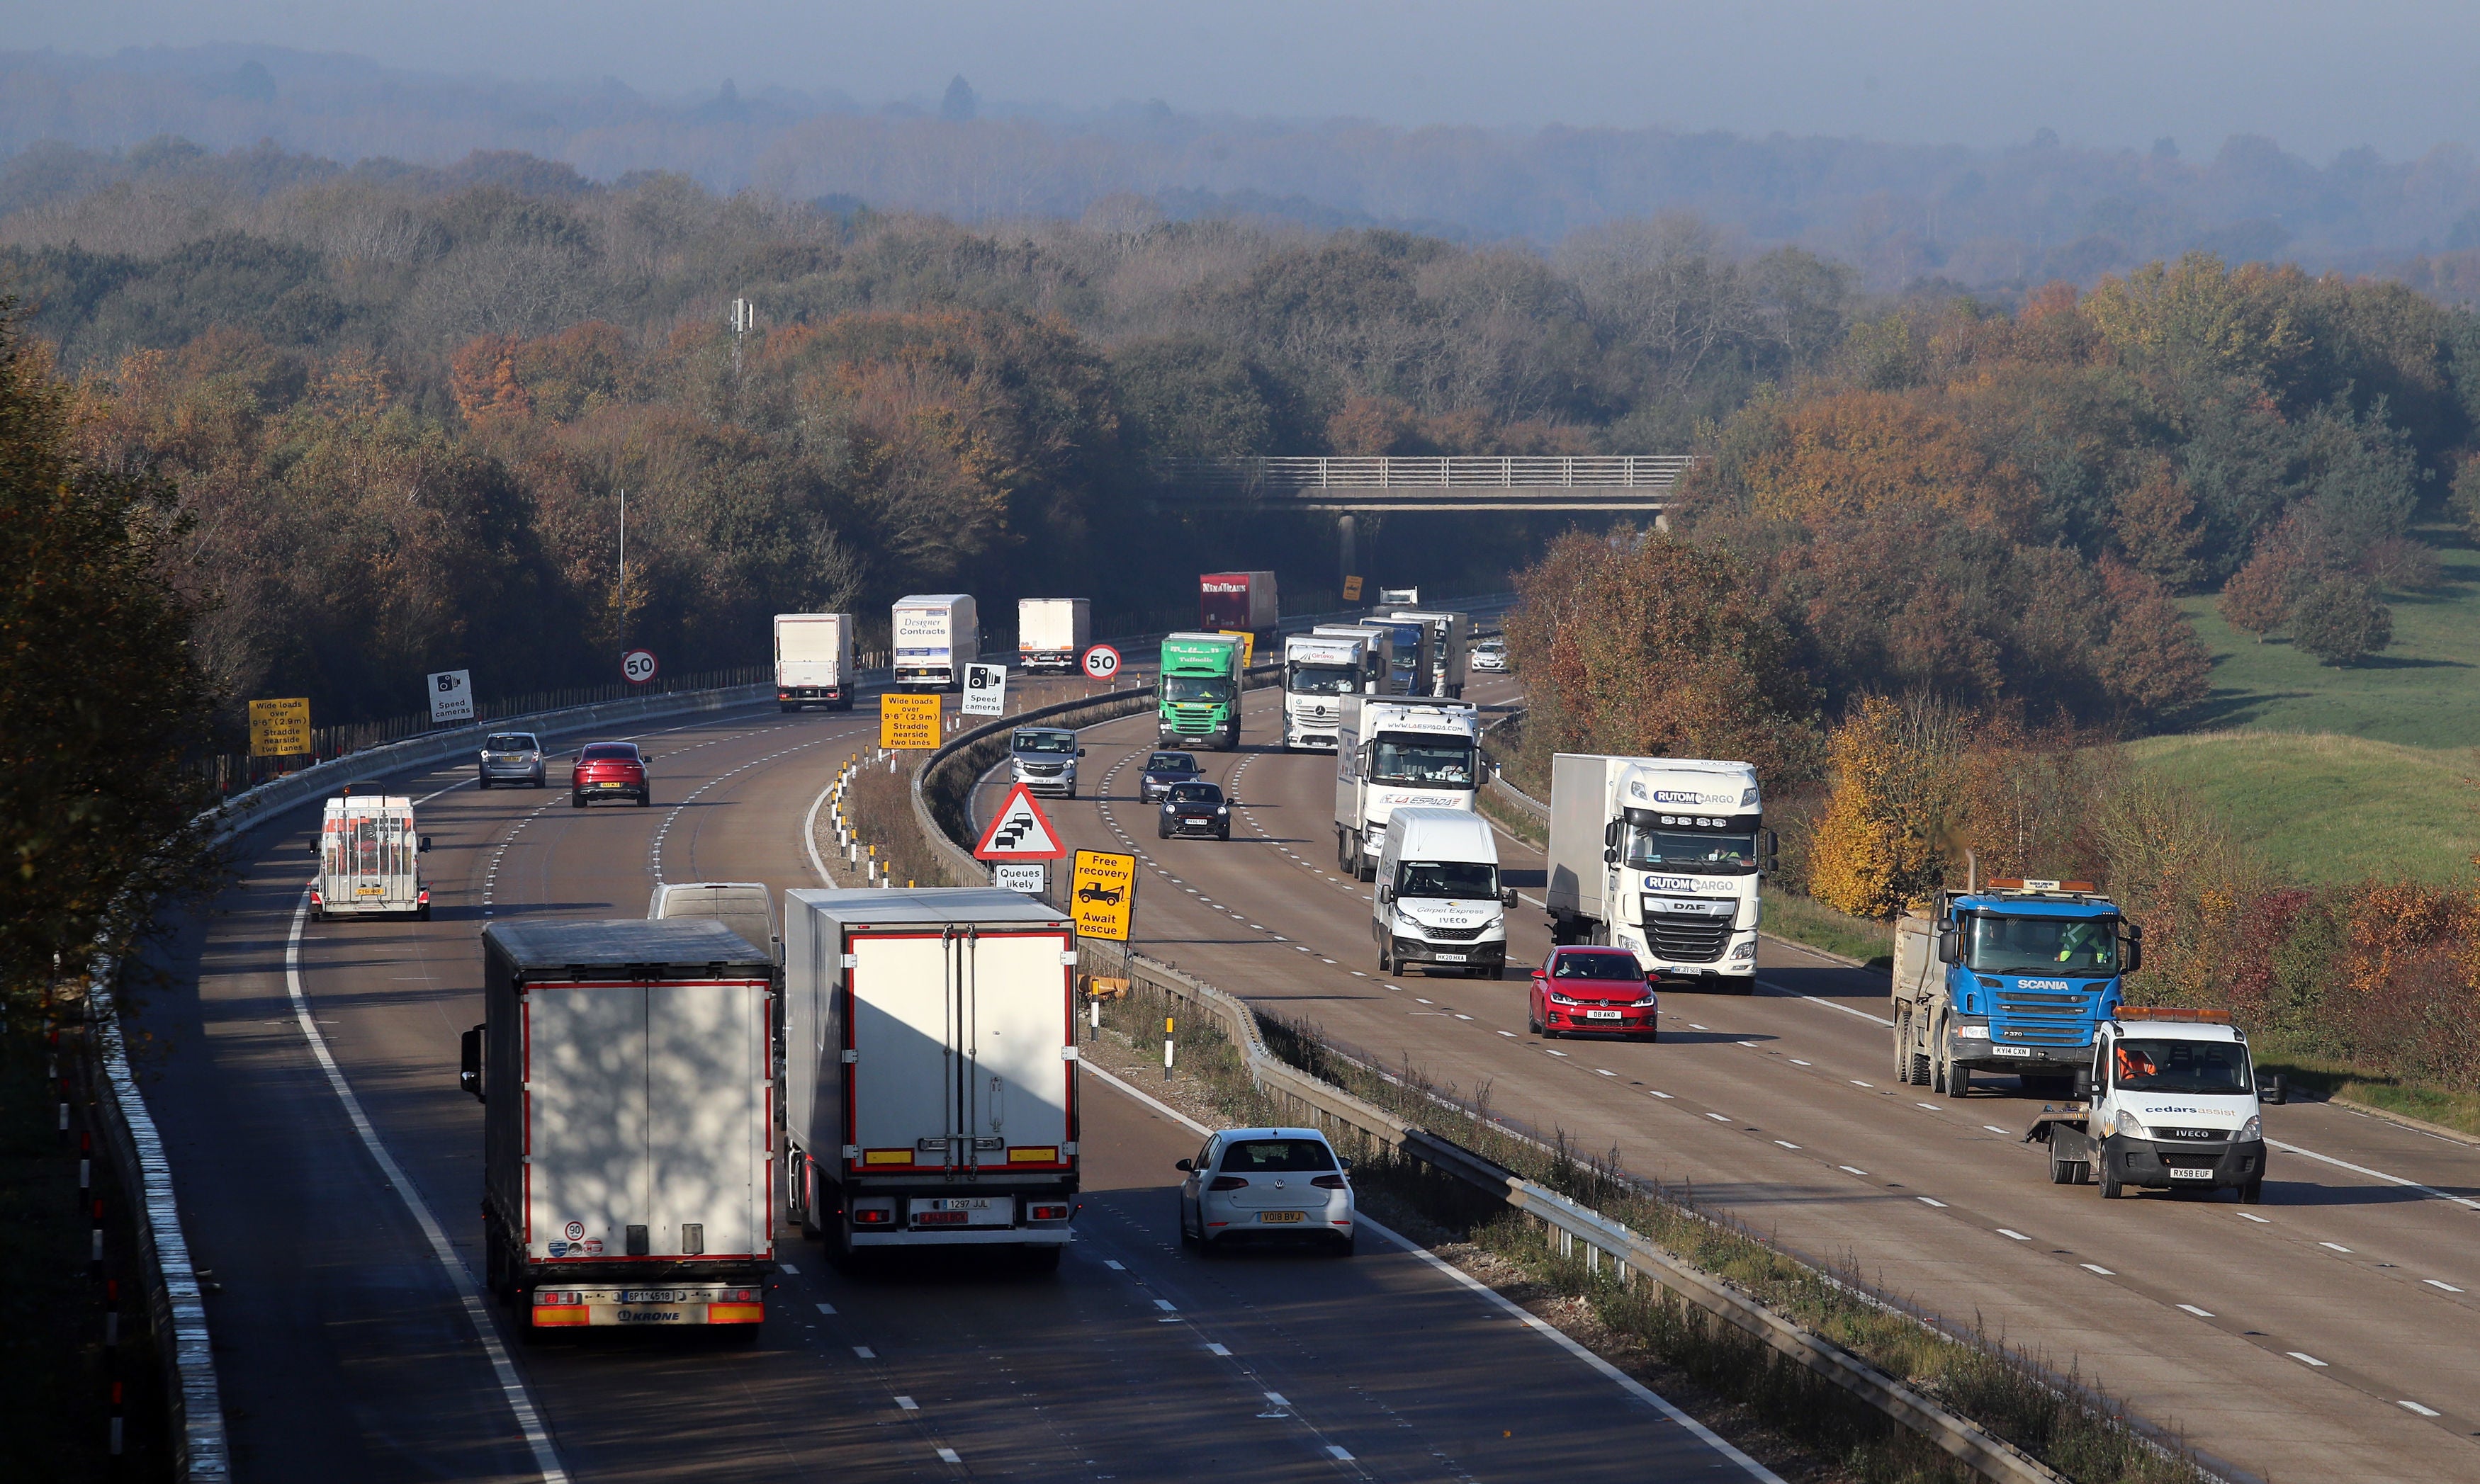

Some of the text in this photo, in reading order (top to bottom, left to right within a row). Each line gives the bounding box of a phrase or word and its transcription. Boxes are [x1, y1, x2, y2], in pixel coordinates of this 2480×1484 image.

[905, 618, 941, 628] Designer
[627, 657, 653, 675] 50
[1090, 655, 1115, 669] 50
[971, 694, 997, 703] Speed
[439, 699, 466, 709] Speed
[435, 708, 470, 718] cameras
[1387, 723, 1463, 732] WWW.LAESPADA.COM
[1409, 797, 1453, 806] ESPADA
[1093, 855, 1117, 866] Free
[1001, 868, 1040, 878] Queues
[1079, 866, 1129, 880] recovery
[1006, 880, 1034, 890] likely
[1674, 902, 1706, 911] DAF
[1083, 912, 1116, 924] Await
[1079, 924, 1117, 935] rescue
[2017, 979, 2069, 991] SCANIA
[2173, 1169, 2194, 1178] RX58
[951, 1199, 970, 1208] 1297
[569, 1225, 580, 1235] 90
[629, 1292, 670, 1301] 6P1 4518
[633, 1312, 680, 1321] KRONE
